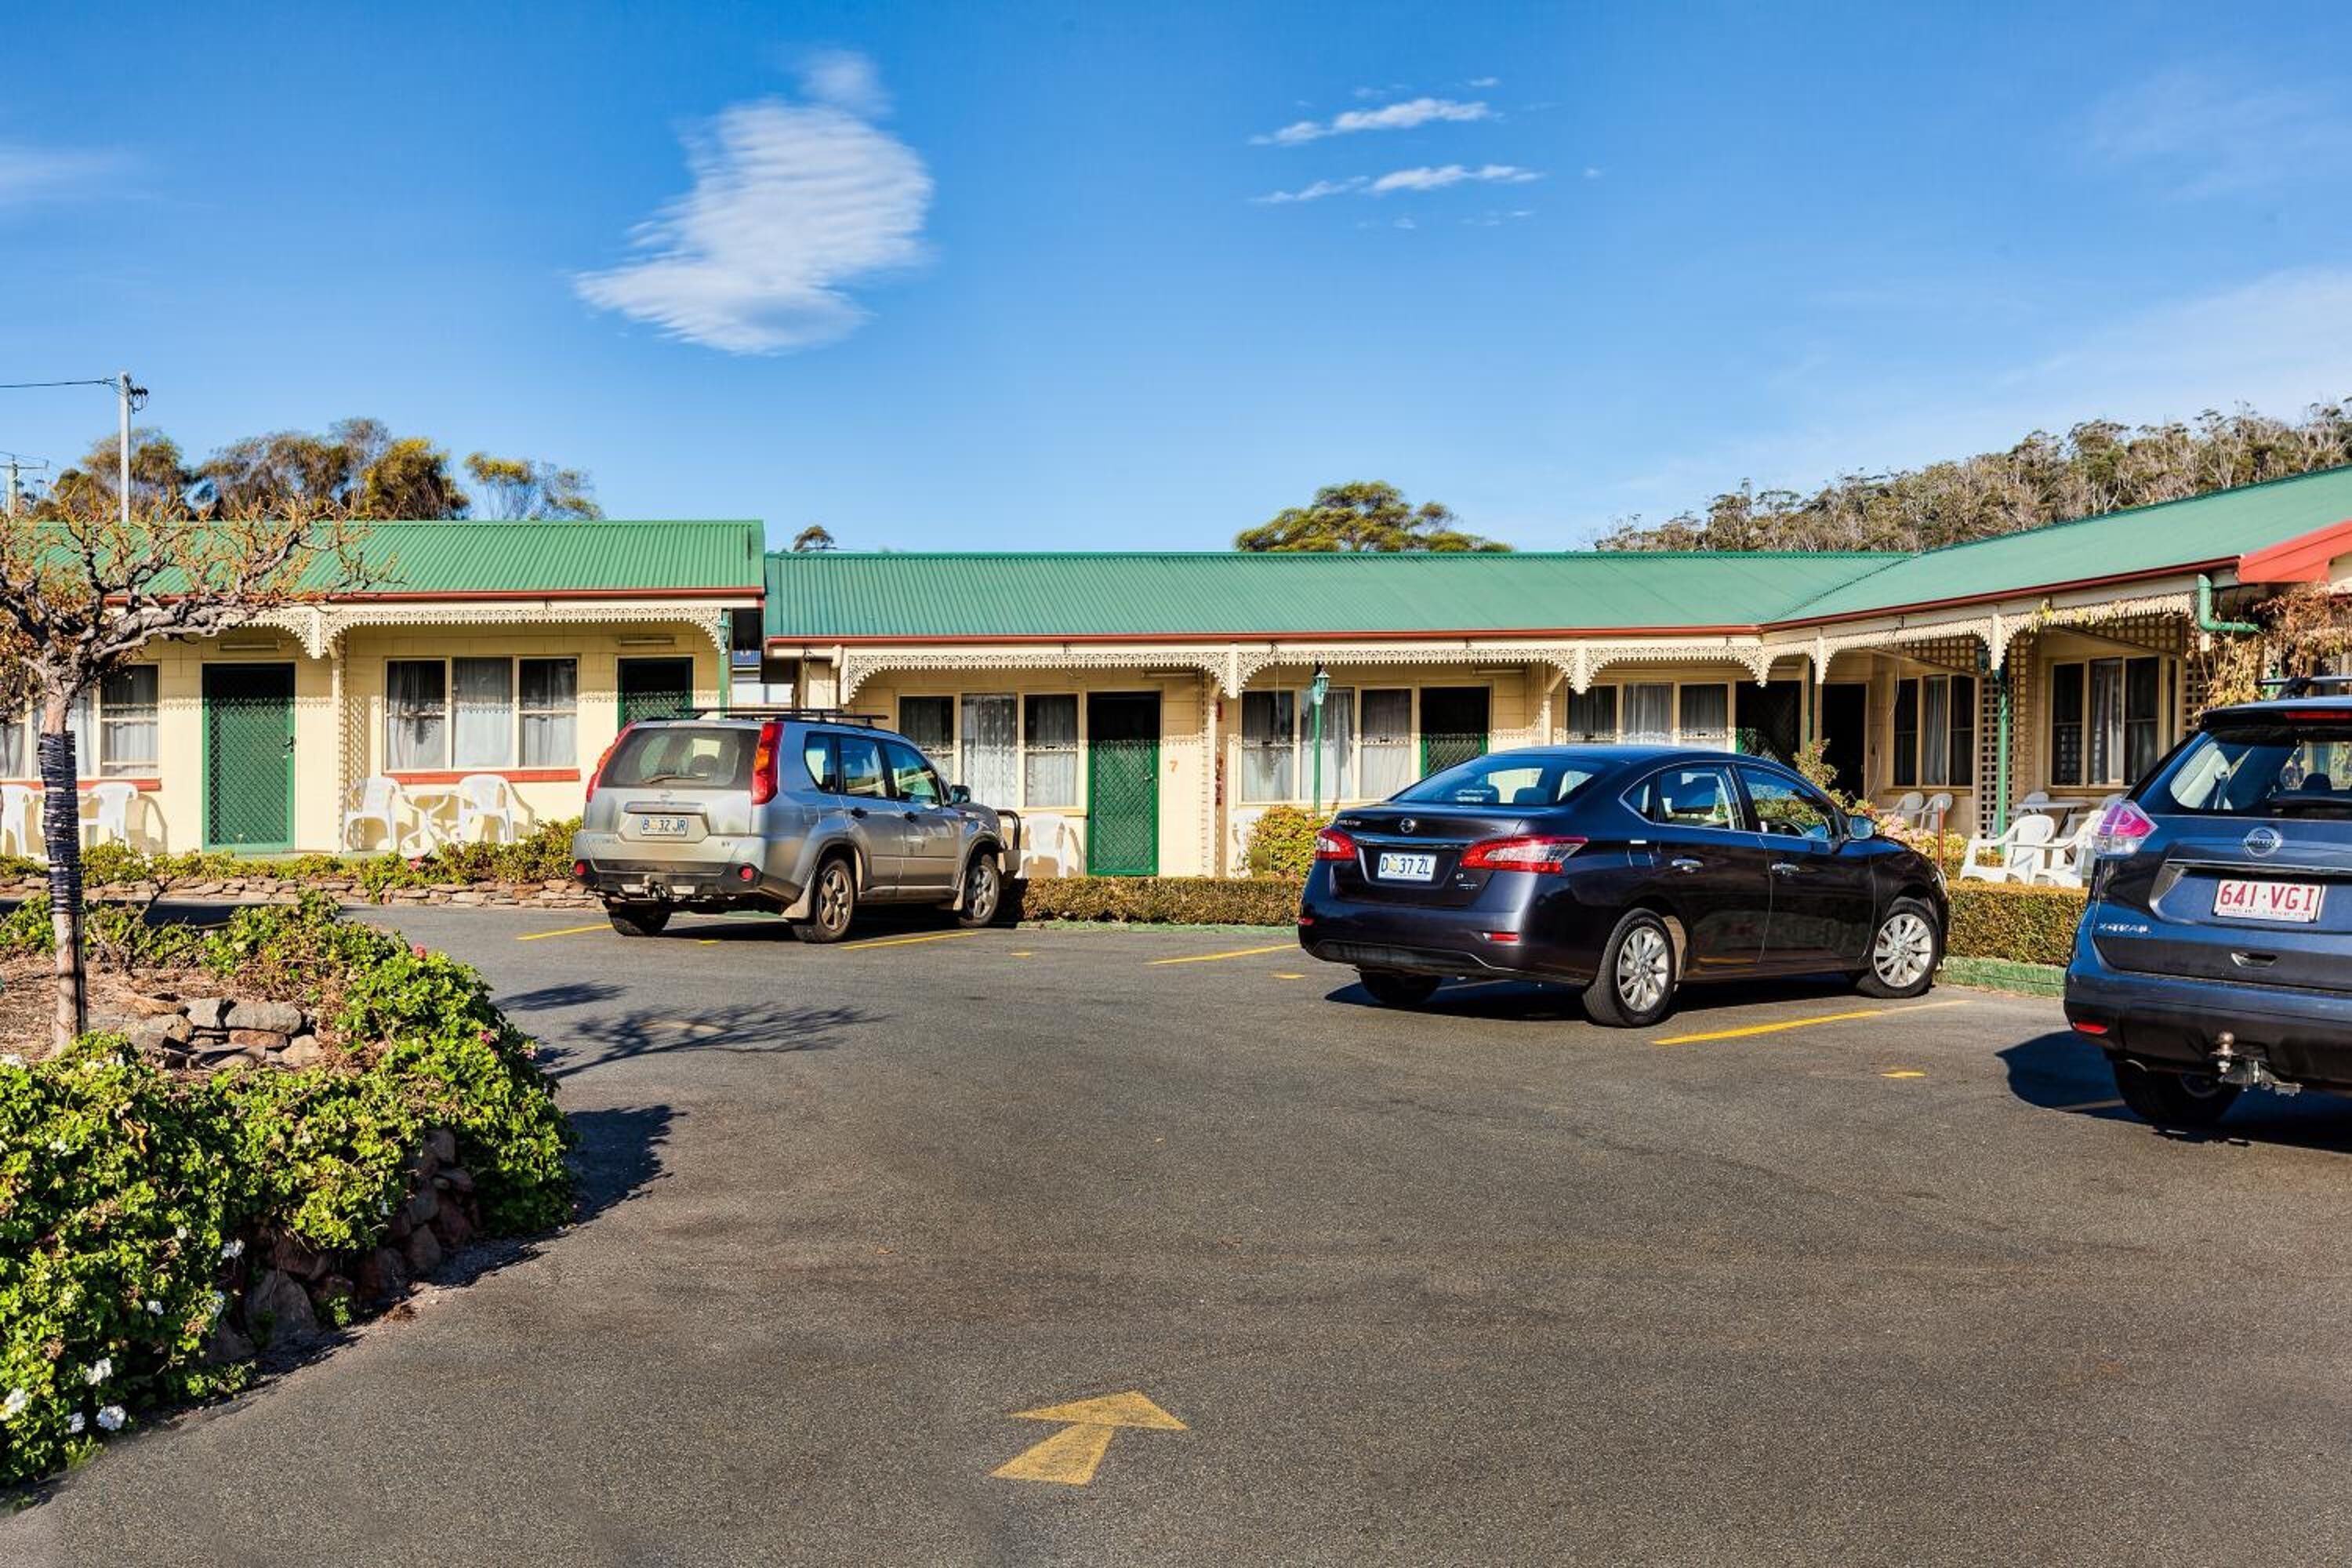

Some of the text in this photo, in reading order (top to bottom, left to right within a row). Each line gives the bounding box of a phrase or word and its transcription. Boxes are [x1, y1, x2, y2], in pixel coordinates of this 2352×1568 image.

[1169, 760, 1178, 772] 7
[1381, 856, 1389, 873] D
[1398, 857, 1414, 874] 37
